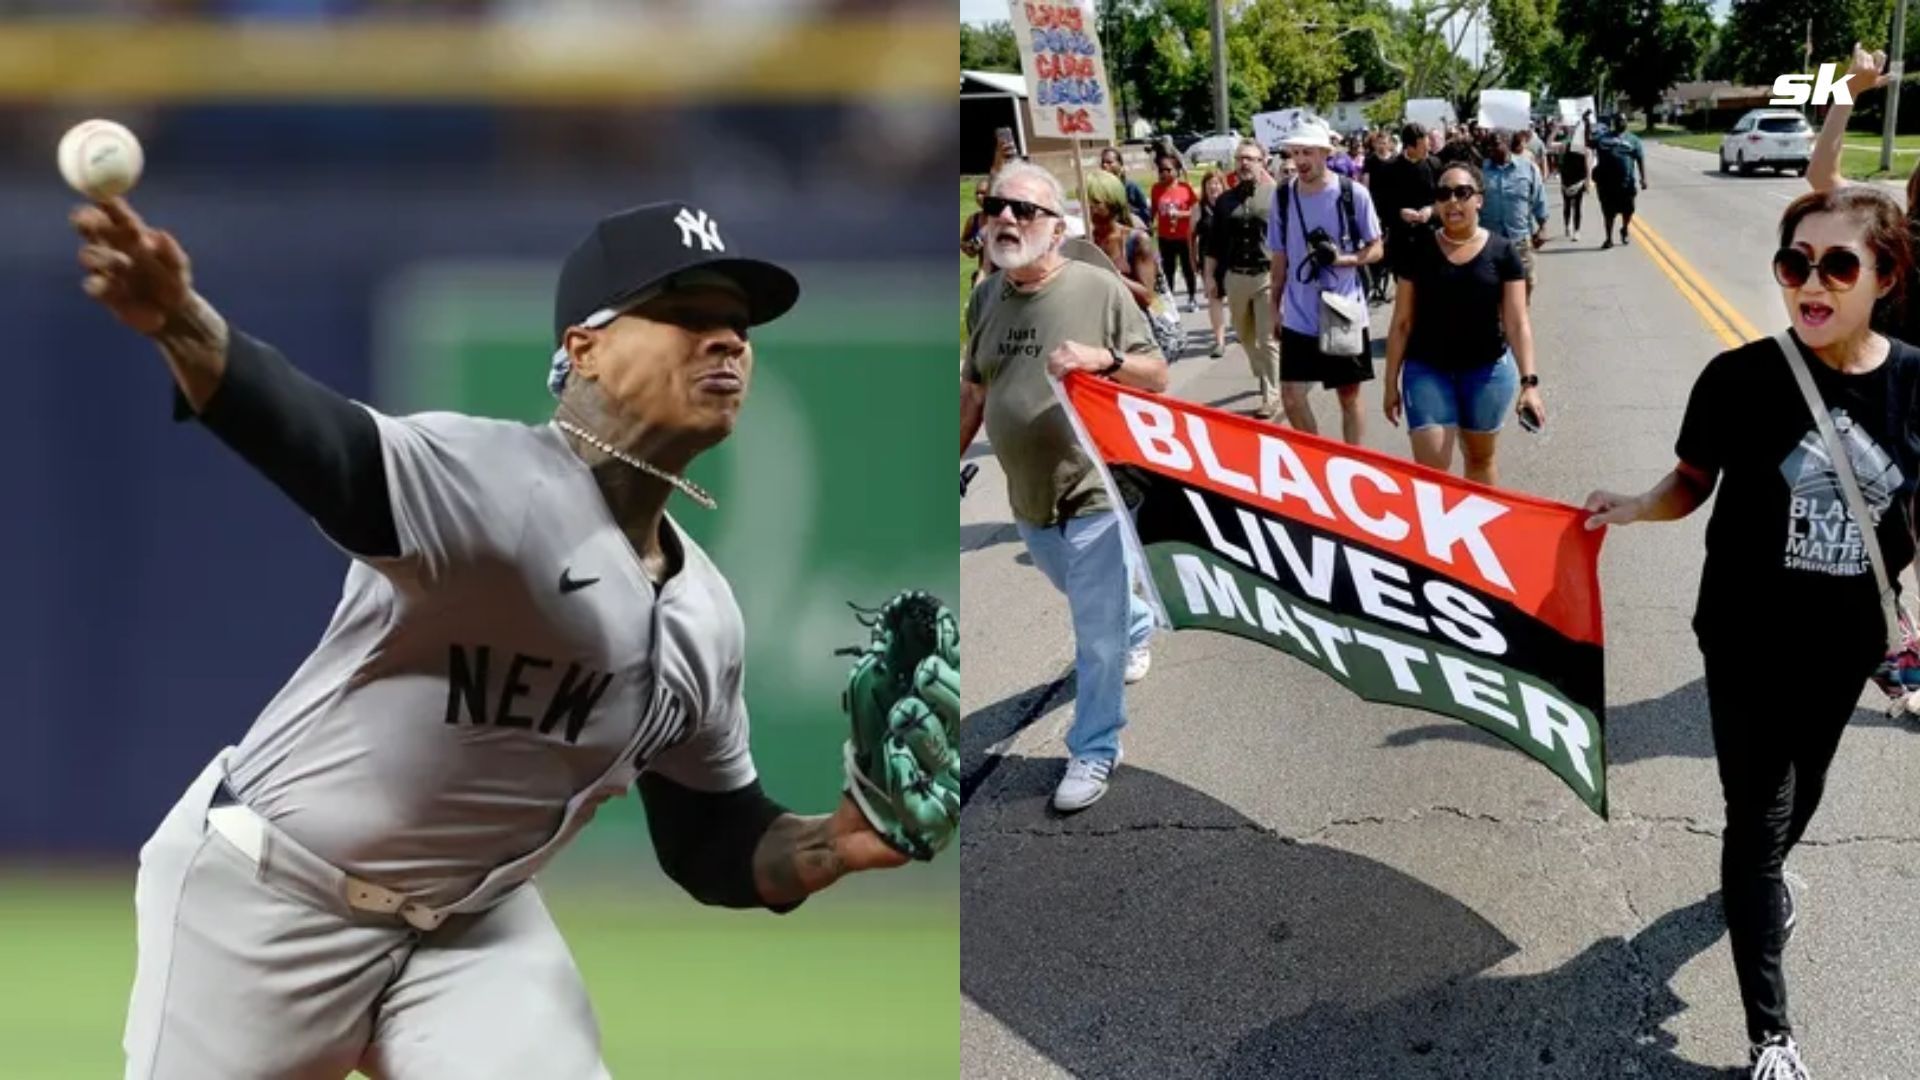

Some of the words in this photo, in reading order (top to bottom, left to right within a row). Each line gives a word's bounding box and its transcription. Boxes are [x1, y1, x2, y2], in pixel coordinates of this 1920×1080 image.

[674, 207, 726, 252] NY
[1007, 328, 1037, 340] Just
[1117, 392, 1518, 595] BLACK
[1787, 518, 1879, 545] LIVE
[1183, 487, 1508, 656] LIVES
[445, 644, 616, 744] NEW
[1172, 553, 1596, 792] MATTER
